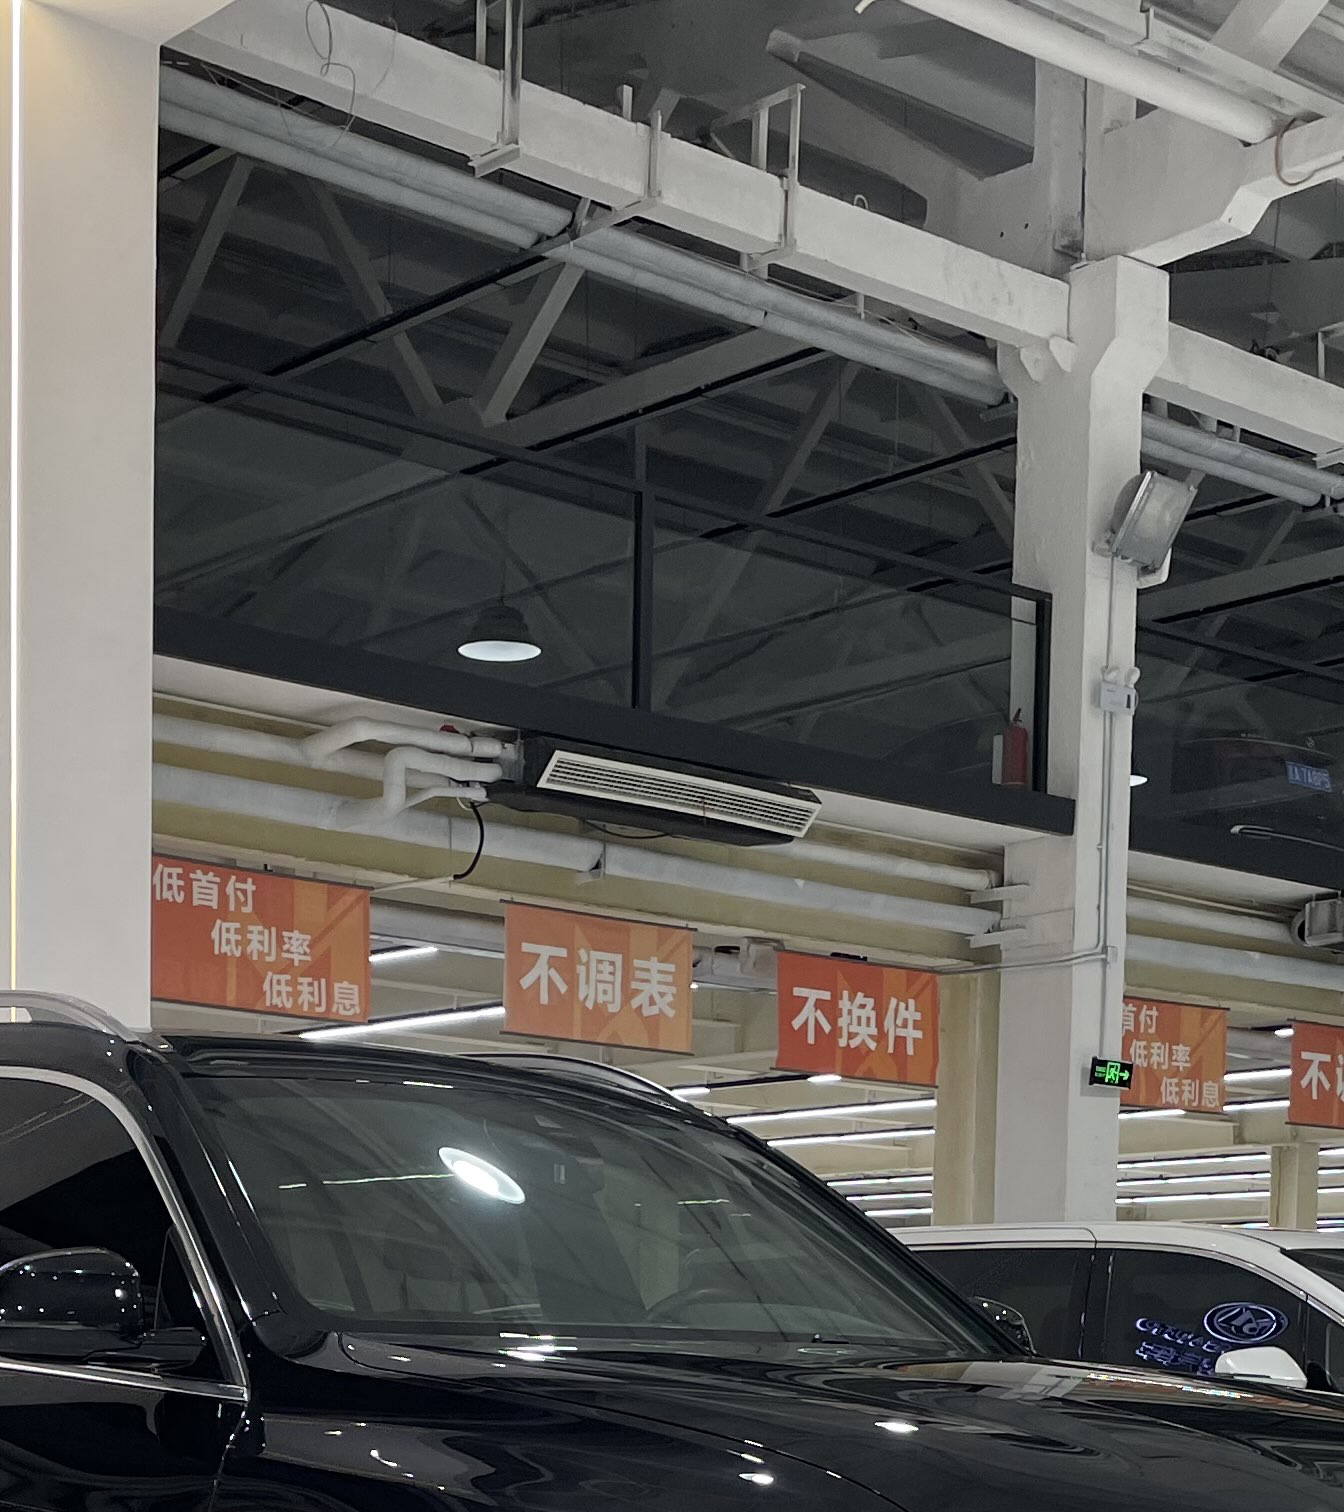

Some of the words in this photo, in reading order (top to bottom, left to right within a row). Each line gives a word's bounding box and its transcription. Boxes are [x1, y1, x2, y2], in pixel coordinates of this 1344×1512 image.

[153, 864, 256, 914] 低首付
[211, 919, 312, 966] 低利率
[263, 972, 361, 1016] 低利息
[519, 942, 677, 1020] 不调表
[790, 986, 924, 1056] 不换件
[1122, 1003, 1158, 1037] 首付
[1130, 1039, 1191, 1071] 低利率
[1161, 1076, 1219, 1107] 低利息
